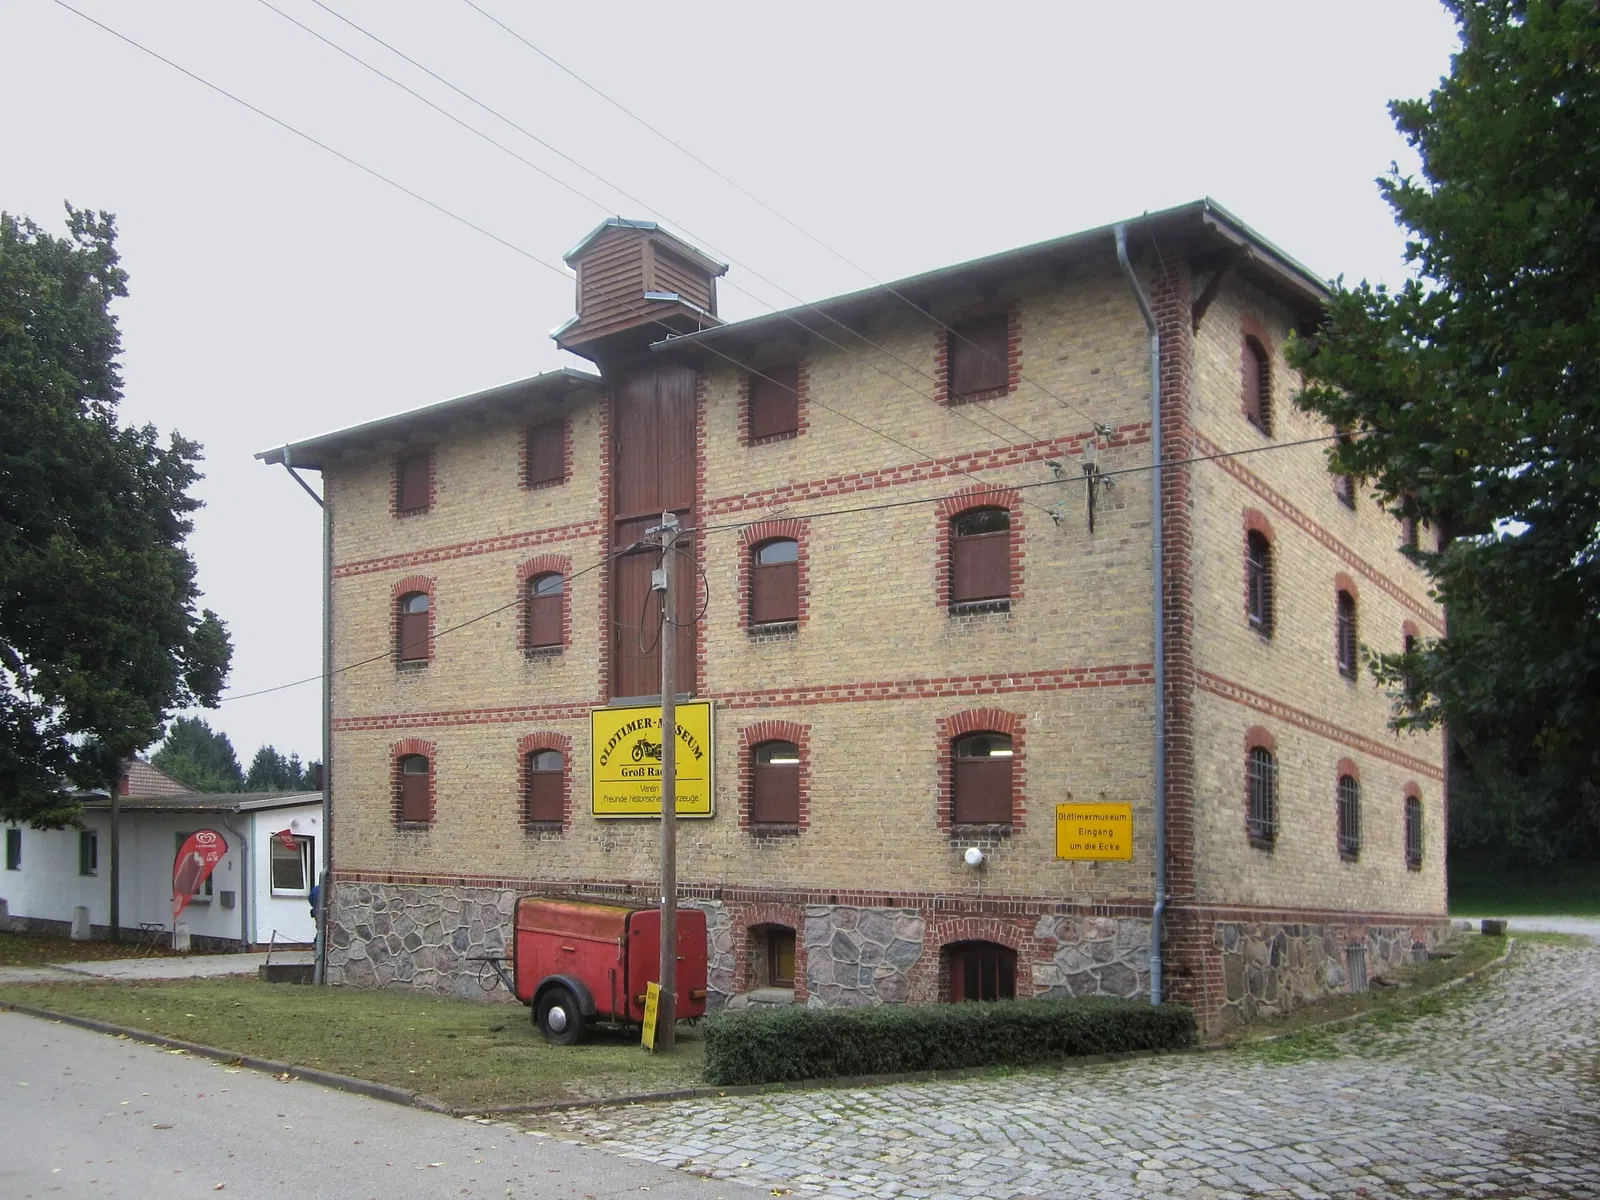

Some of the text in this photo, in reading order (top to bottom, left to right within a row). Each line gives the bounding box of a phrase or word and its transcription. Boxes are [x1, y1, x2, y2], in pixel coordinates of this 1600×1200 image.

[599, 717, 704, 767] OLDTIMER-SEUM
[621, 767, 645, 777] Groß
[640, 784, 659, 793] Verein
[629, 794, 663, 803] historische
[1058, 813, 1127, 821] Oldtimermuseum
[1078, 828, 1114, 838] Eingang
[1084, 842, 1097, 850] die
[1098, 843, 1120, 851] Ecke
